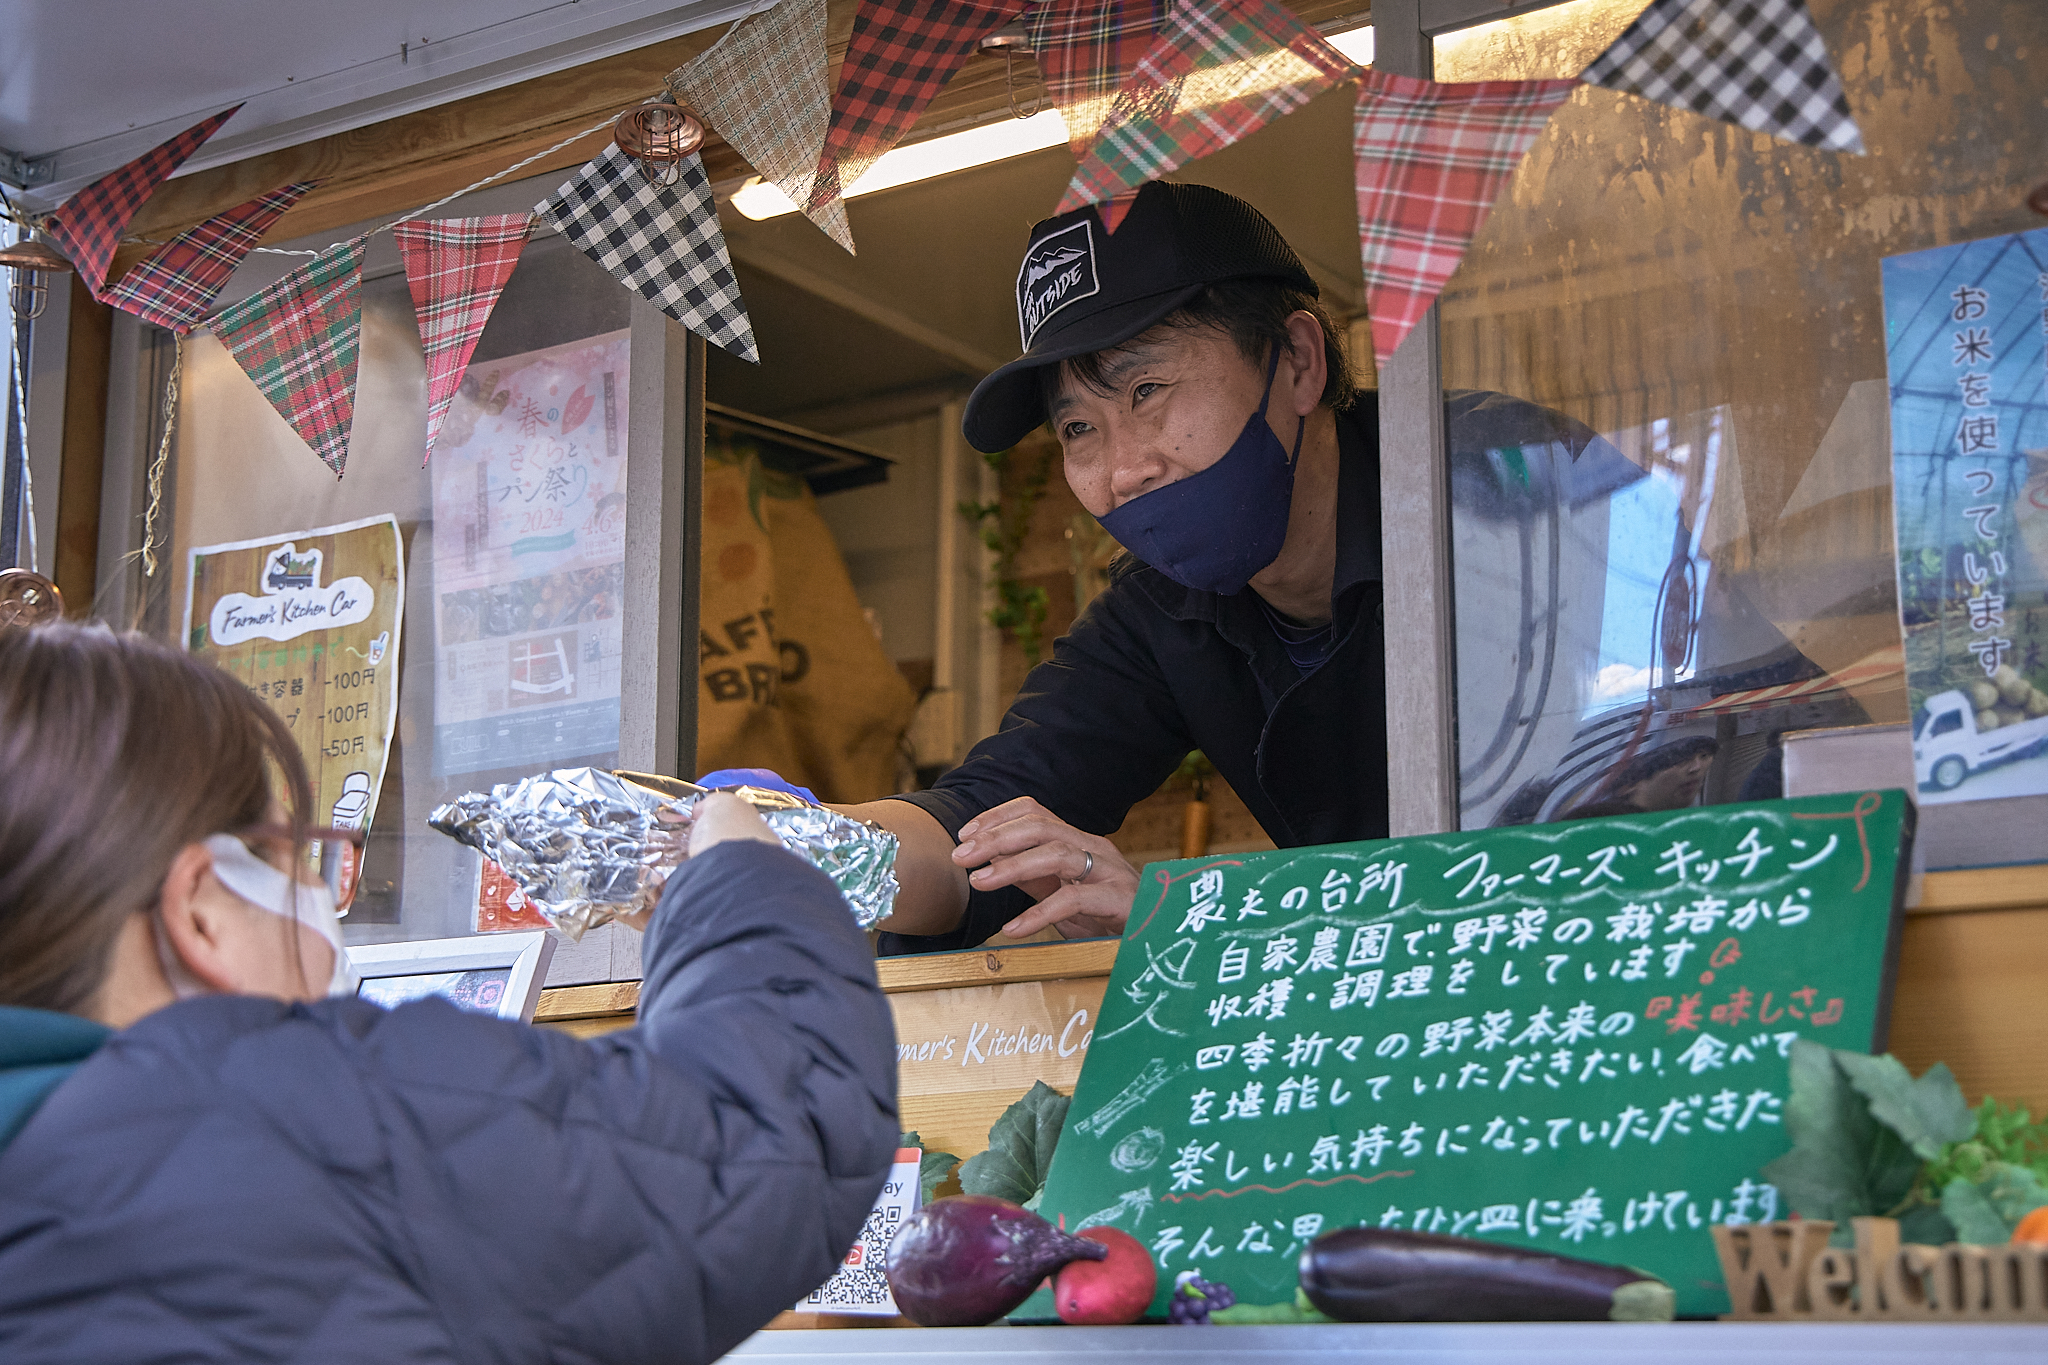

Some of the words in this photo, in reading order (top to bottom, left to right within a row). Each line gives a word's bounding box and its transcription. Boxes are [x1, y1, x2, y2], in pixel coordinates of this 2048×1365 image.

[517, 397, 559, 439] 春の
[508, 436, 578, 471] さくらと
[497, 464, 588, 508] パン祭り
[1954, 285, 2009, 676] お米を使っています
[520, 508, 564, 534] 2024
[222, 605, 277, 633] Farmer's
[281, 599, 326, 625] Kitchen
[331, 590, 357, 617] Car
[1176, 860, 1408, 932] 農夫の台所
[1443, 843, 1638, 899] ファーマーズ
[1655, 827, 1838, 883] キッチン
[895, 1035, 957, 1062] mer's
[962, 1022, 1053, 1066] Kitchen
